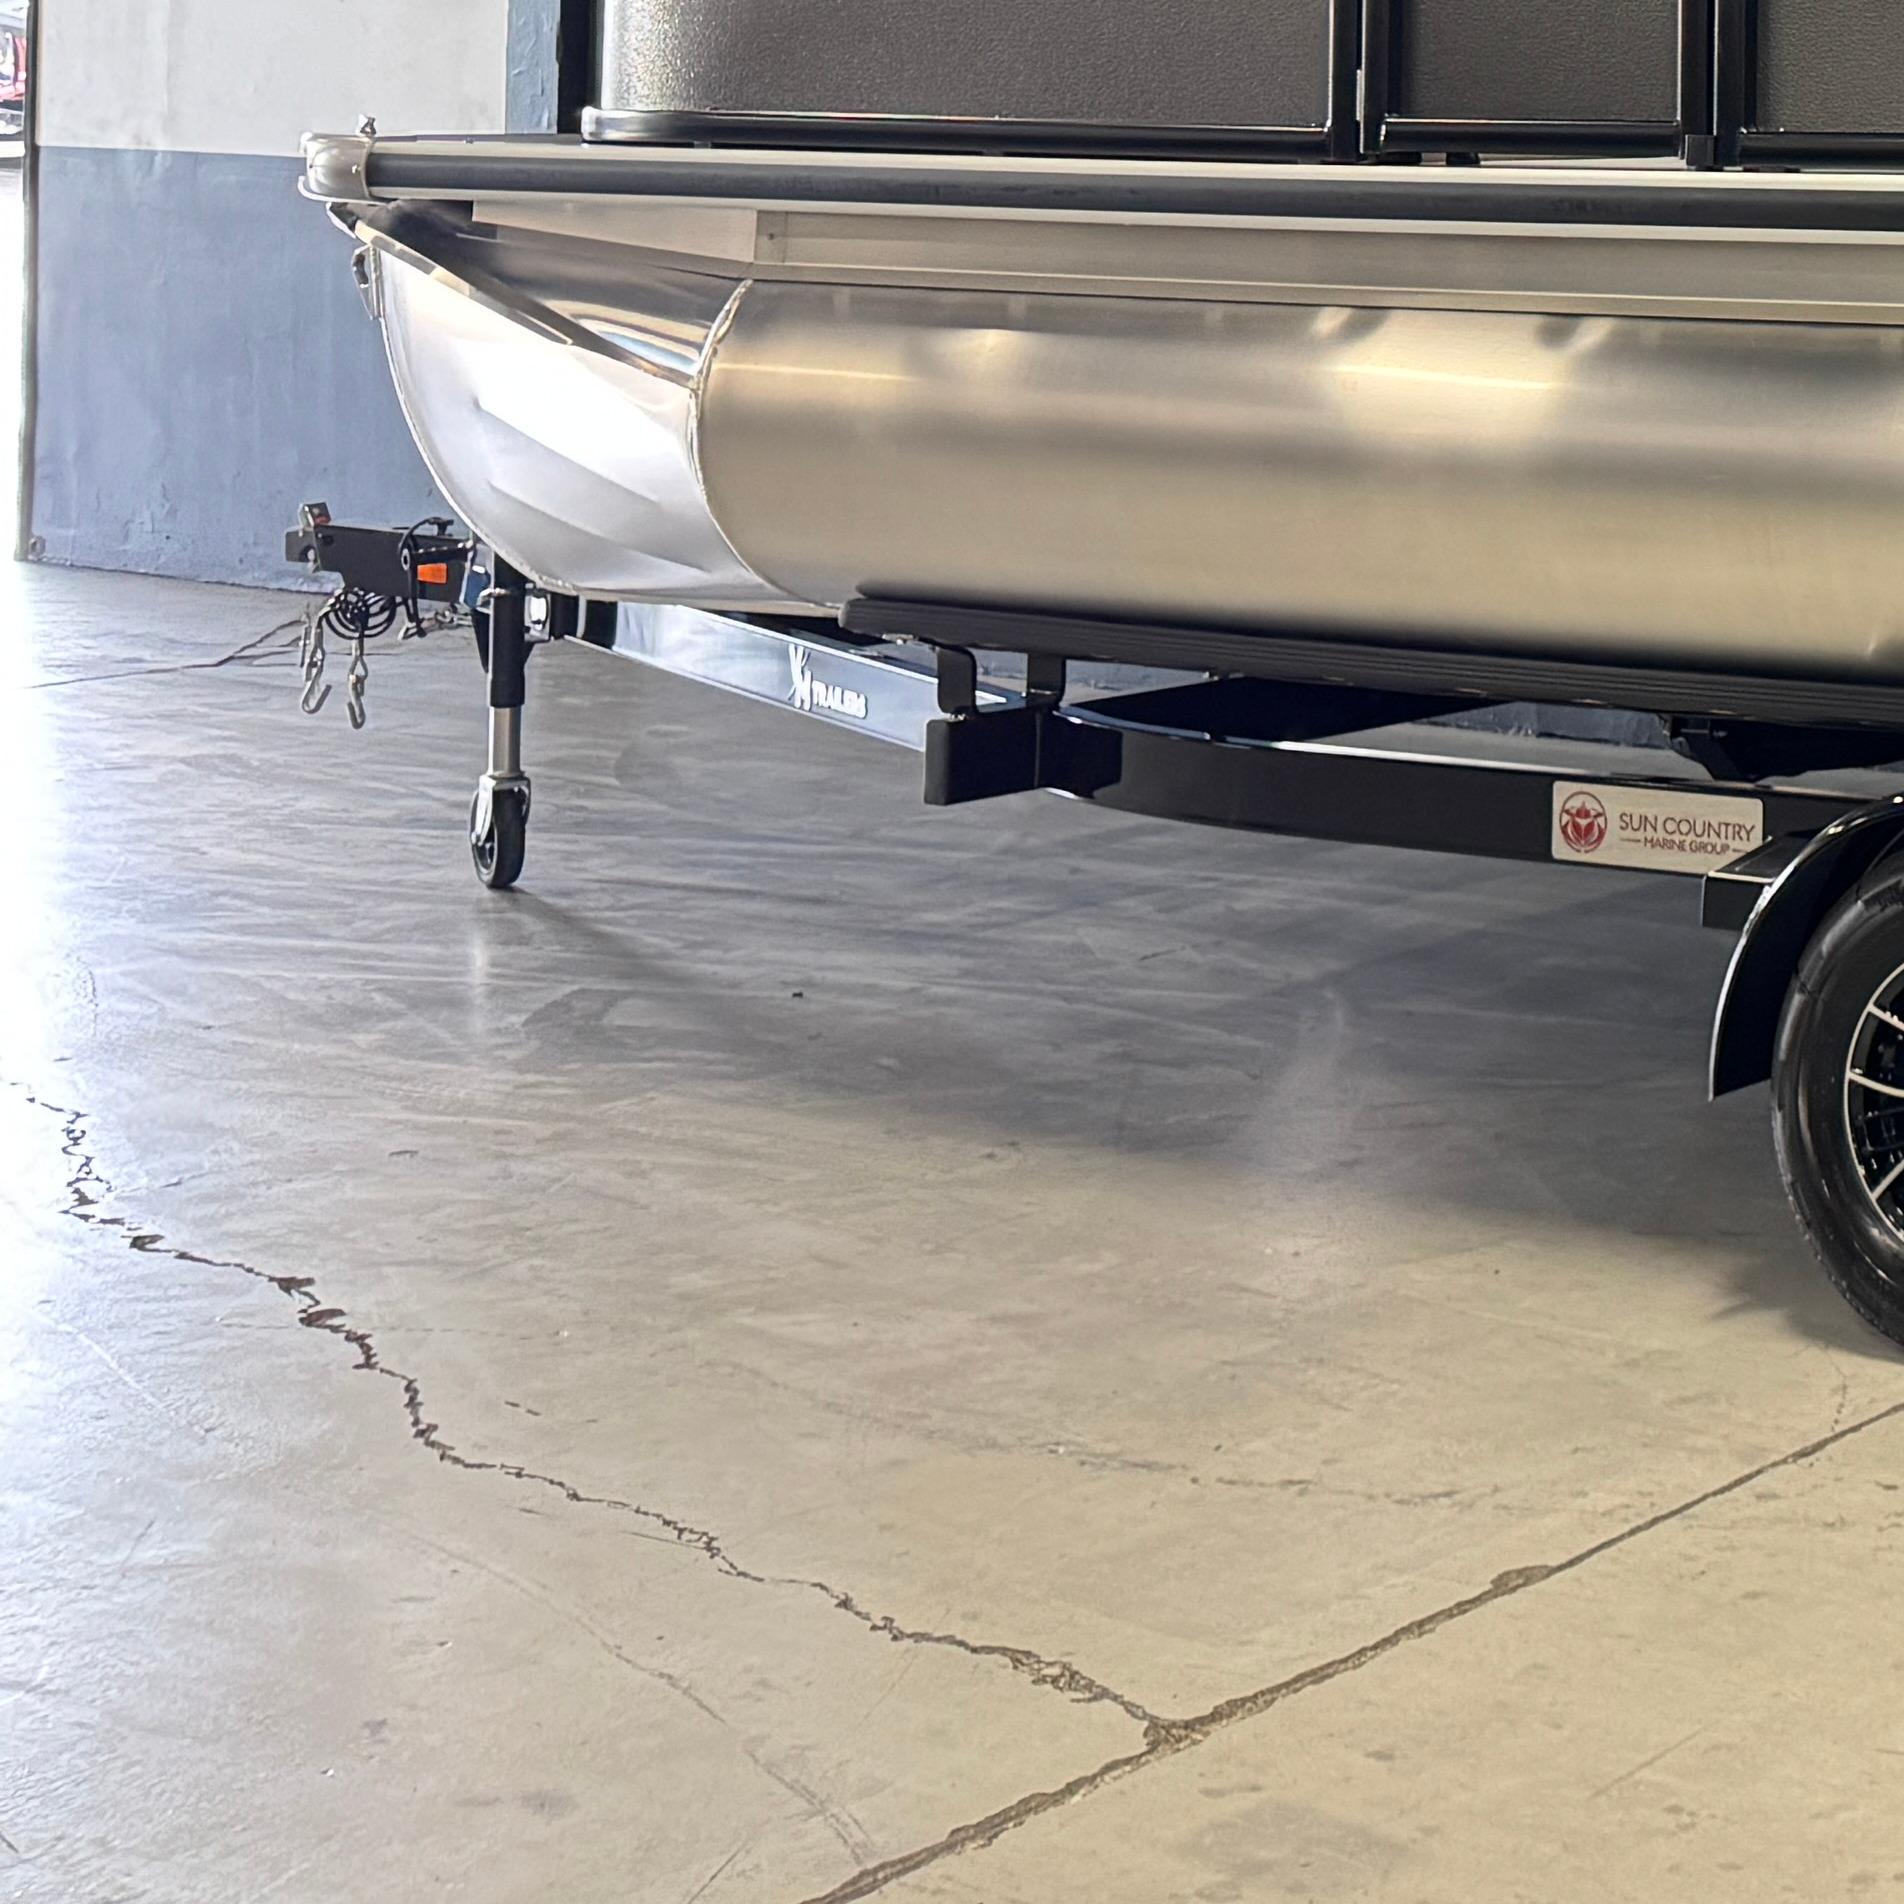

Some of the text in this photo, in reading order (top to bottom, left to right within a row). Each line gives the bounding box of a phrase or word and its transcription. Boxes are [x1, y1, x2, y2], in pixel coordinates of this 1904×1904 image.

[1619, 812, 1756, 842] SUN COUNTRY
[1643, 836, 1730, 855] MARINE GROUP
